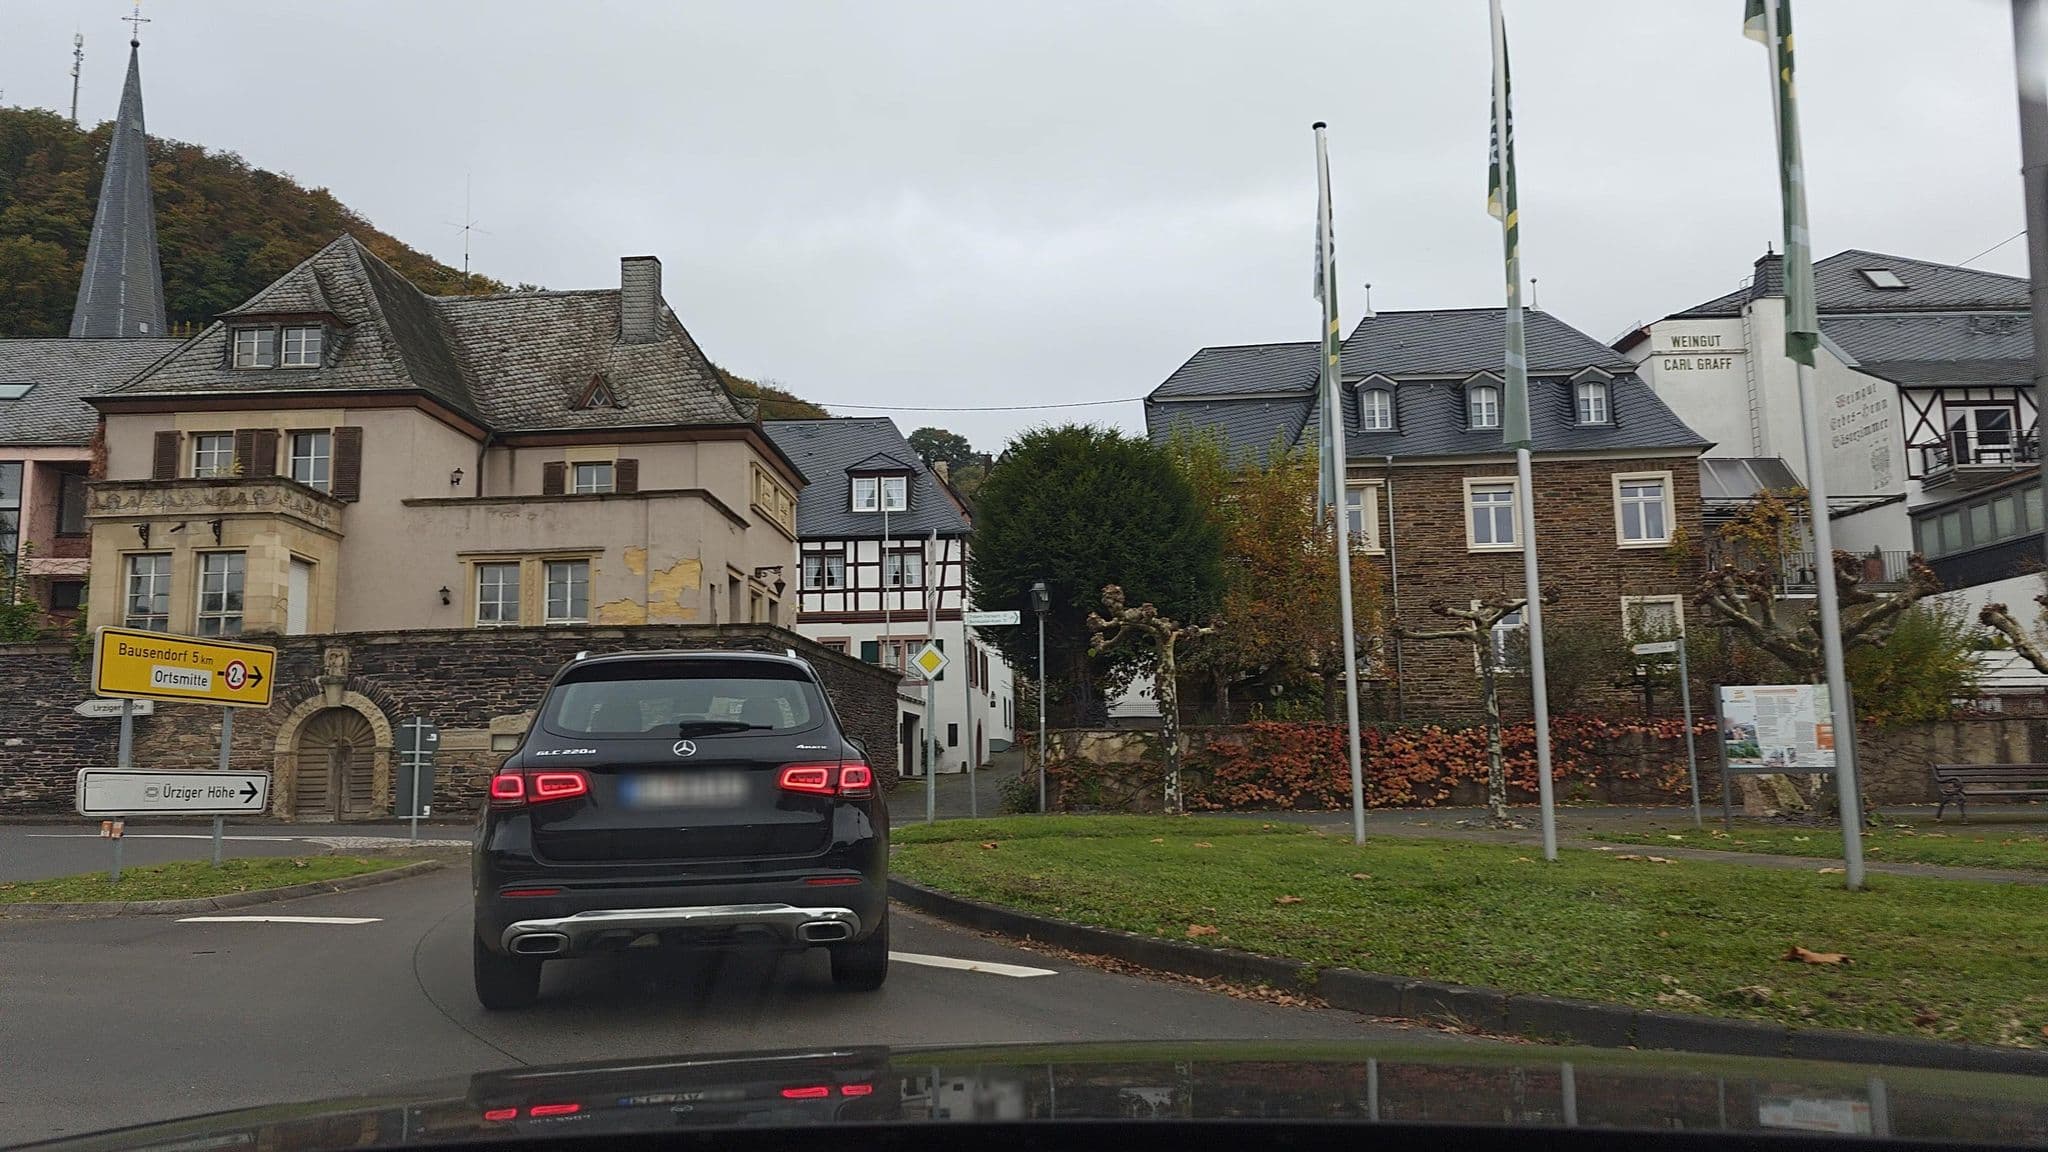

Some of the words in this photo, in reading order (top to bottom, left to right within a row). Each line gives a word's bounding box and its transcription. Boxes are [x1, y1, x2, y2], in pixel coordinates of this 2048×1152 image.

[1671, 335, 1721, 348] WEINGUT
[1664, 358, 1693, 371] CARL
[1697, 357, 1732, 370] GRAFF
[118, 642, 189, 662] Bausendorf
[192, 651, 200, 664] 5
[200, 655, 214, 665] km
[154, 670, 208, 687] Ortsmitte
[163, 783, 204, 802] Ürziger
[207, 785, 236, 799] Höhe
